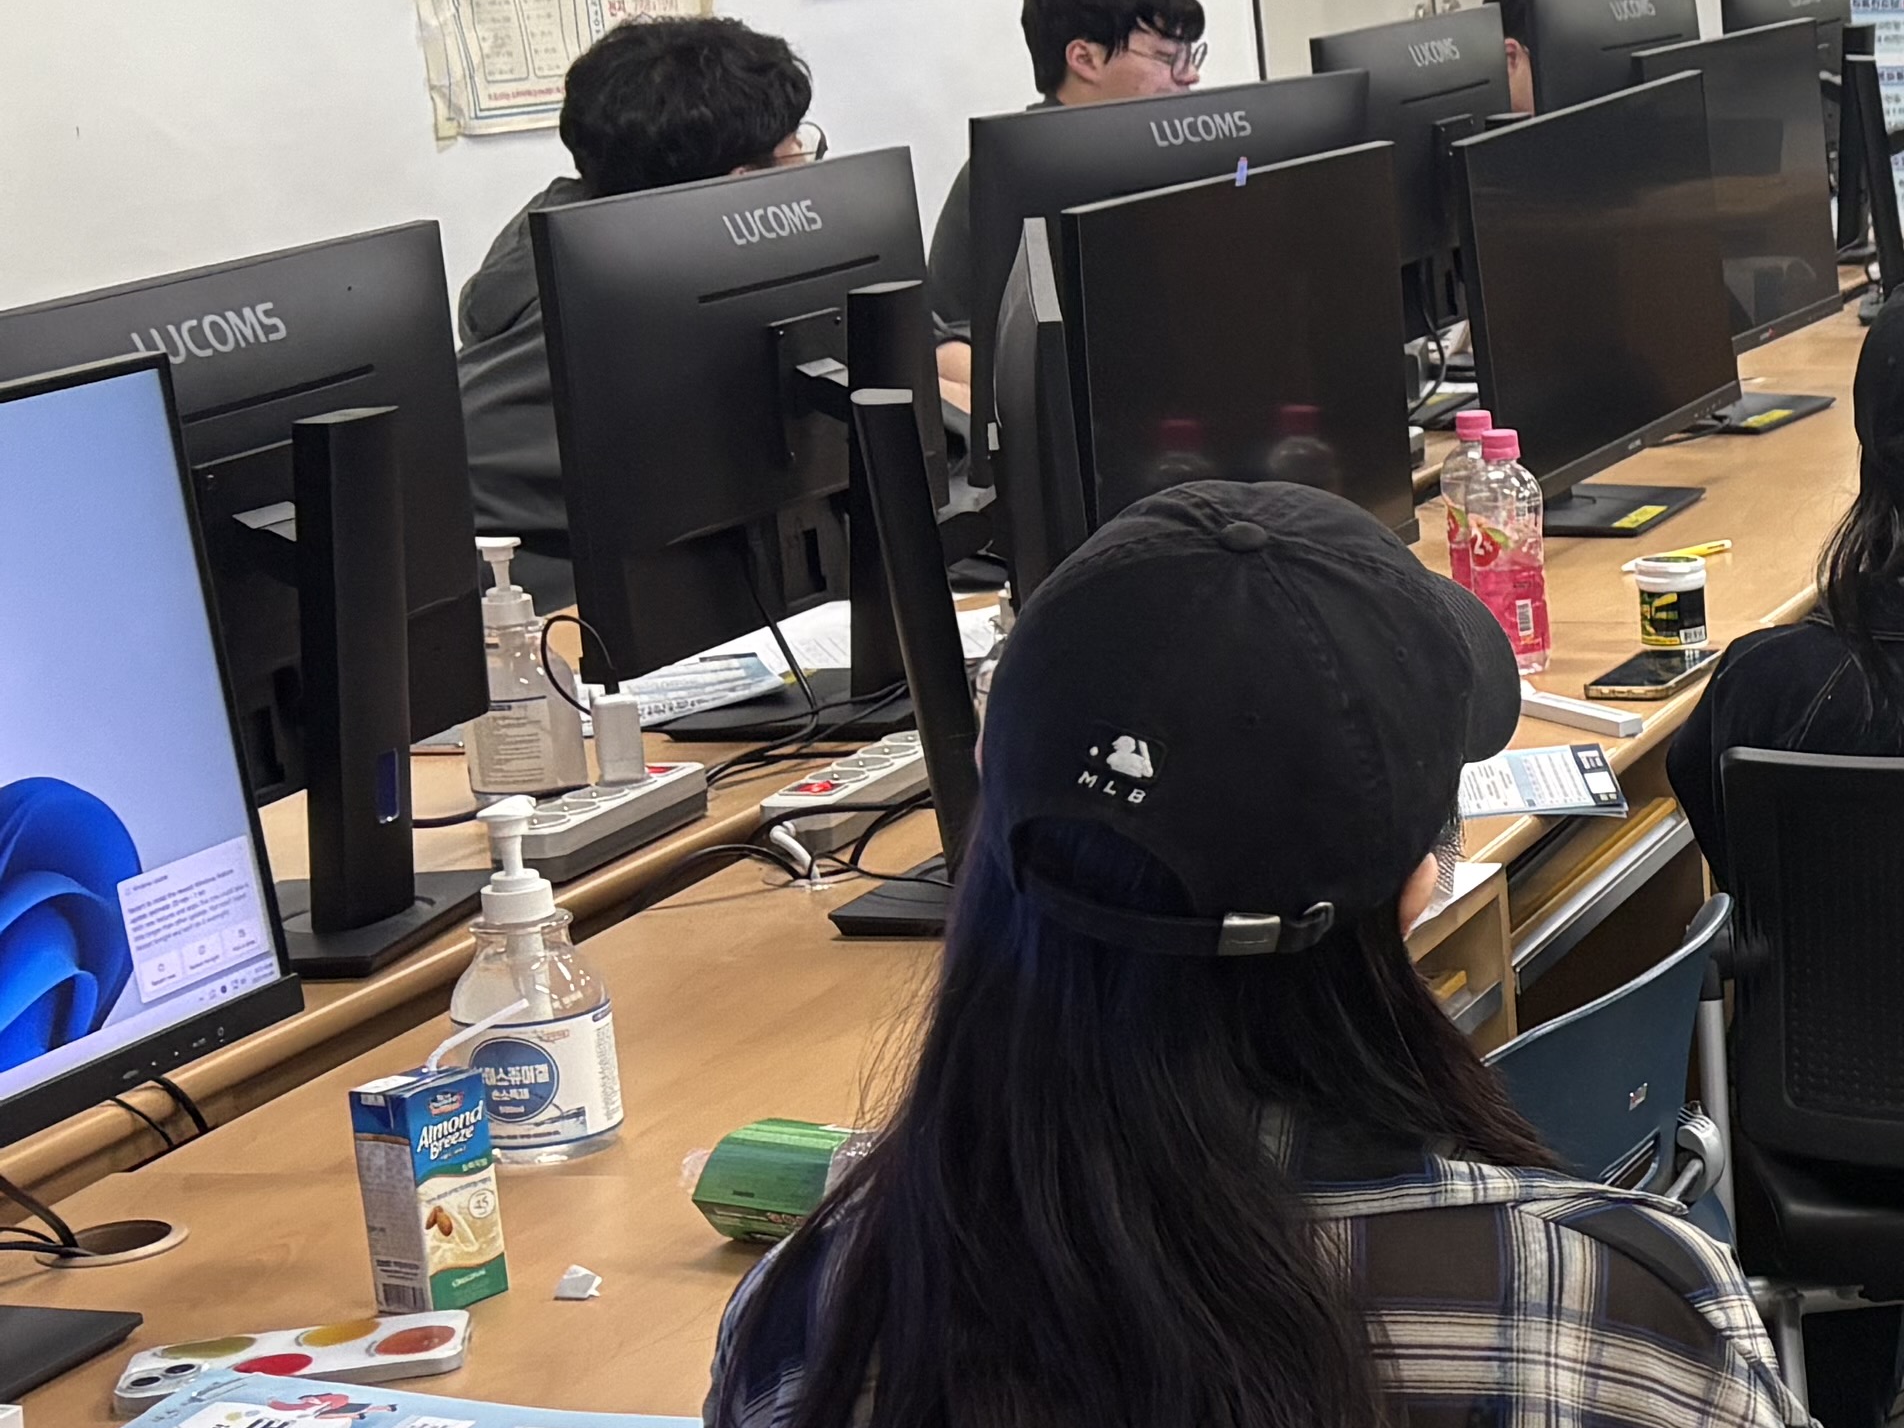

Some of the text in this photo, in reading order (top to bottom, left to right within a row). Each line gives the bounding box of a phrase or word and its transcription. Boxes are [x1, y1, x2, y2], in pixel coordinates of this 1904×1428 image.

[1409, 37, 1461, 67] LUCOMS
[1150, 109, 1252, 148] LUCOMS
[724, 198, 823, 247] LUCOMS
[416, 1099, 484, 1154] Almond
[429, 1124, 475, 1162] Breeze
